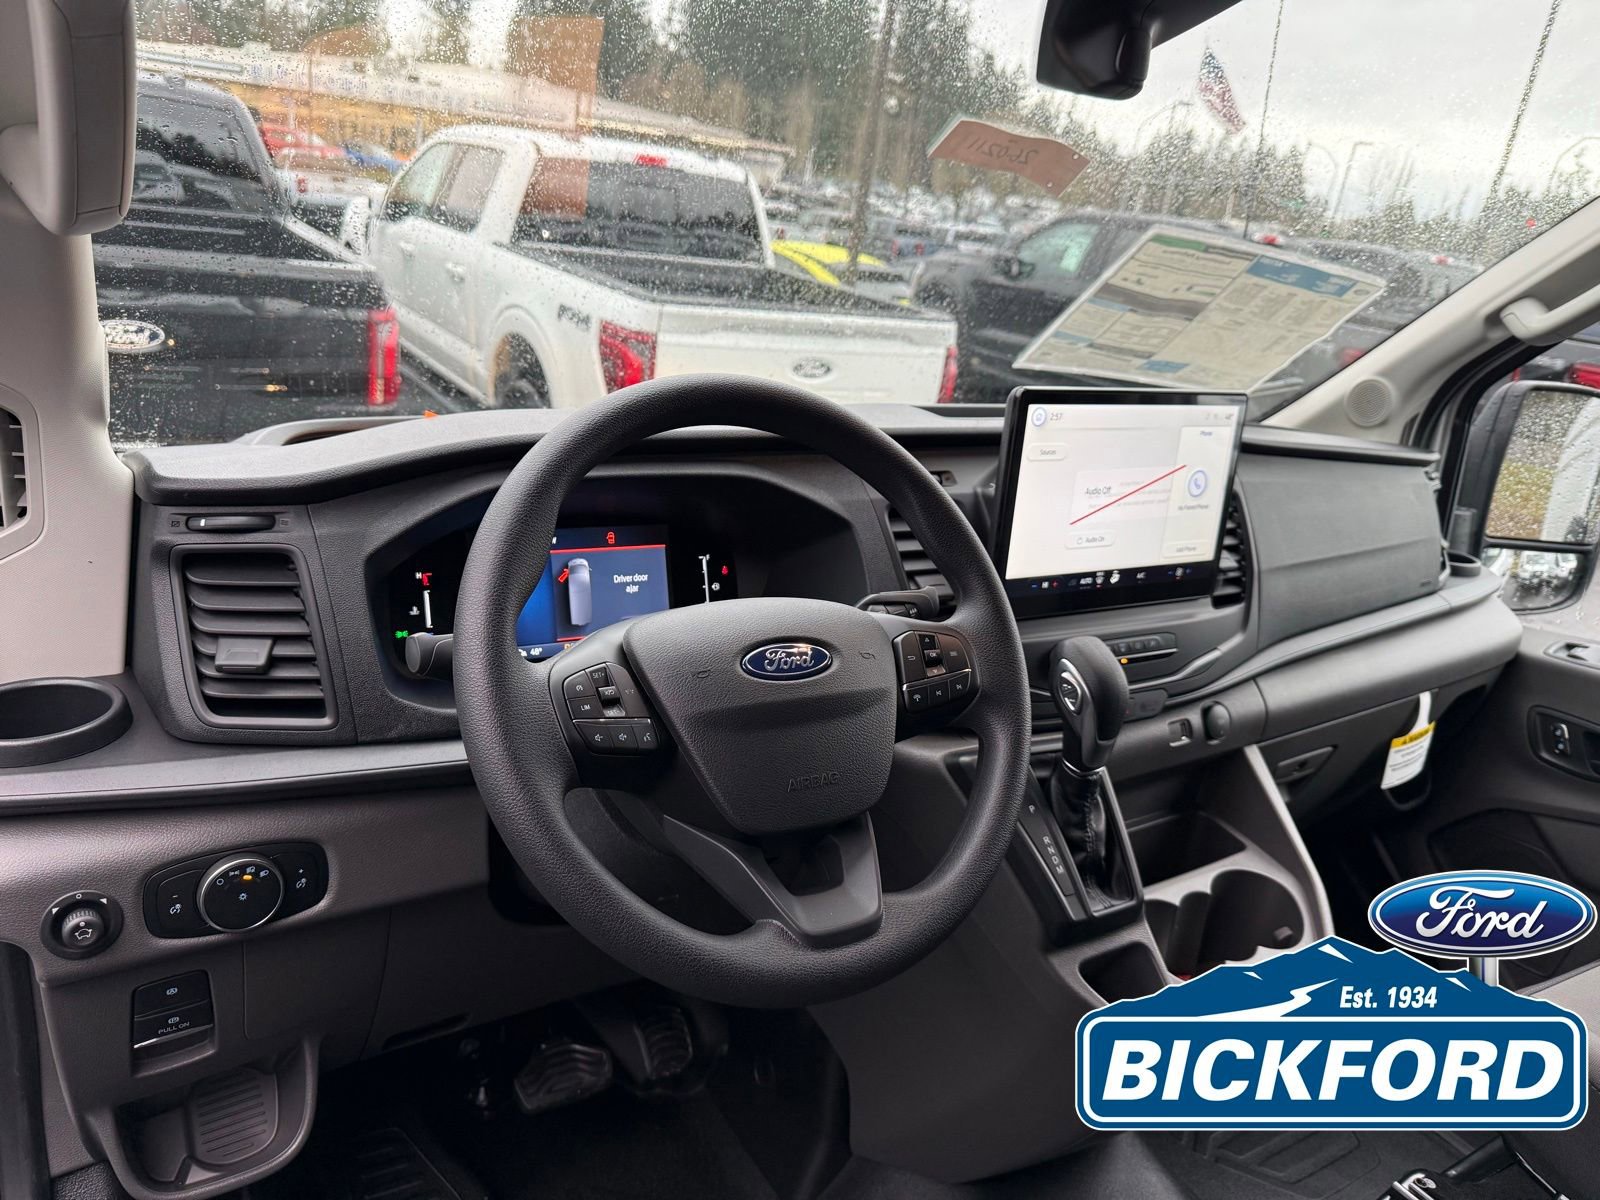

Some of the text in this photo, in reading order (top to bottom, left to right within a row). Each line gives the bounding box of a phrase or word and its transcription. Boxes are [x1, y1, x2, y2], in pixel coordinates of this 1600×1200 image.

[1085, 487, 1101, 495] Audio
[613, 573, 648, 583] Driver door
[626, 585, 639, 594] ajar
[764, 646, 814, 671] Ford
[787, 772, 840, 792] AIRBAG
[1028, 804, 1036, 814] P
[1043, 835, 1051, 845] R
[1051, 855, 1059, 865] D
[158, 1021, 190, 1035] PULL ON
